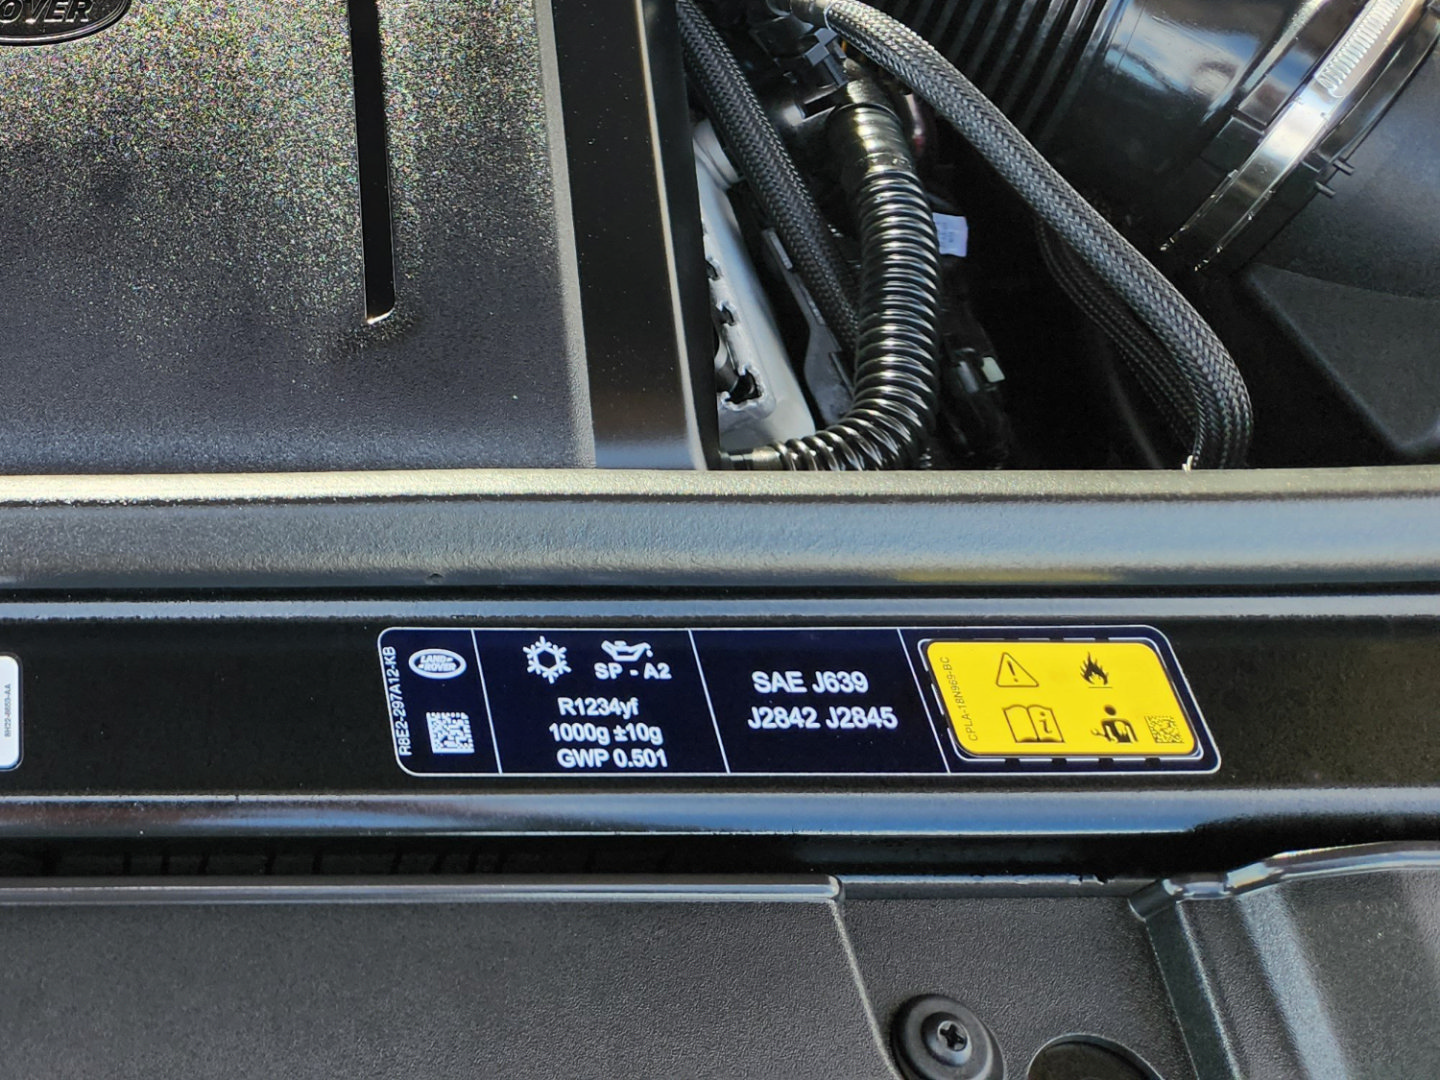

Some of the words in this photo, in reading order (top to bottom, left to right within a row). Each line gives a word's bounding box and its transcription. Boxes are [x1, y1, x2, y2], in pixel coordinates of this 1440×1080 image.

[594, 662, 623, 680] SP
[644, 662, 672, 680] A2
[751, 670, 808, 694] SAE
[811, 670, 869, 694] J639
[382, 646, 413, 757] R8E2-297A12-KB
[557, 697, 640, 720] R1234yf
[747, 706, 822, 729] J2842
[825, 706, 899, 729] J2845
[548, 722, 611, 746] 1000g
[612, 722, 664, 746] ±10g
[556, 748, 610, 768] GWP
[612, 748, 668, 768] 0.501
